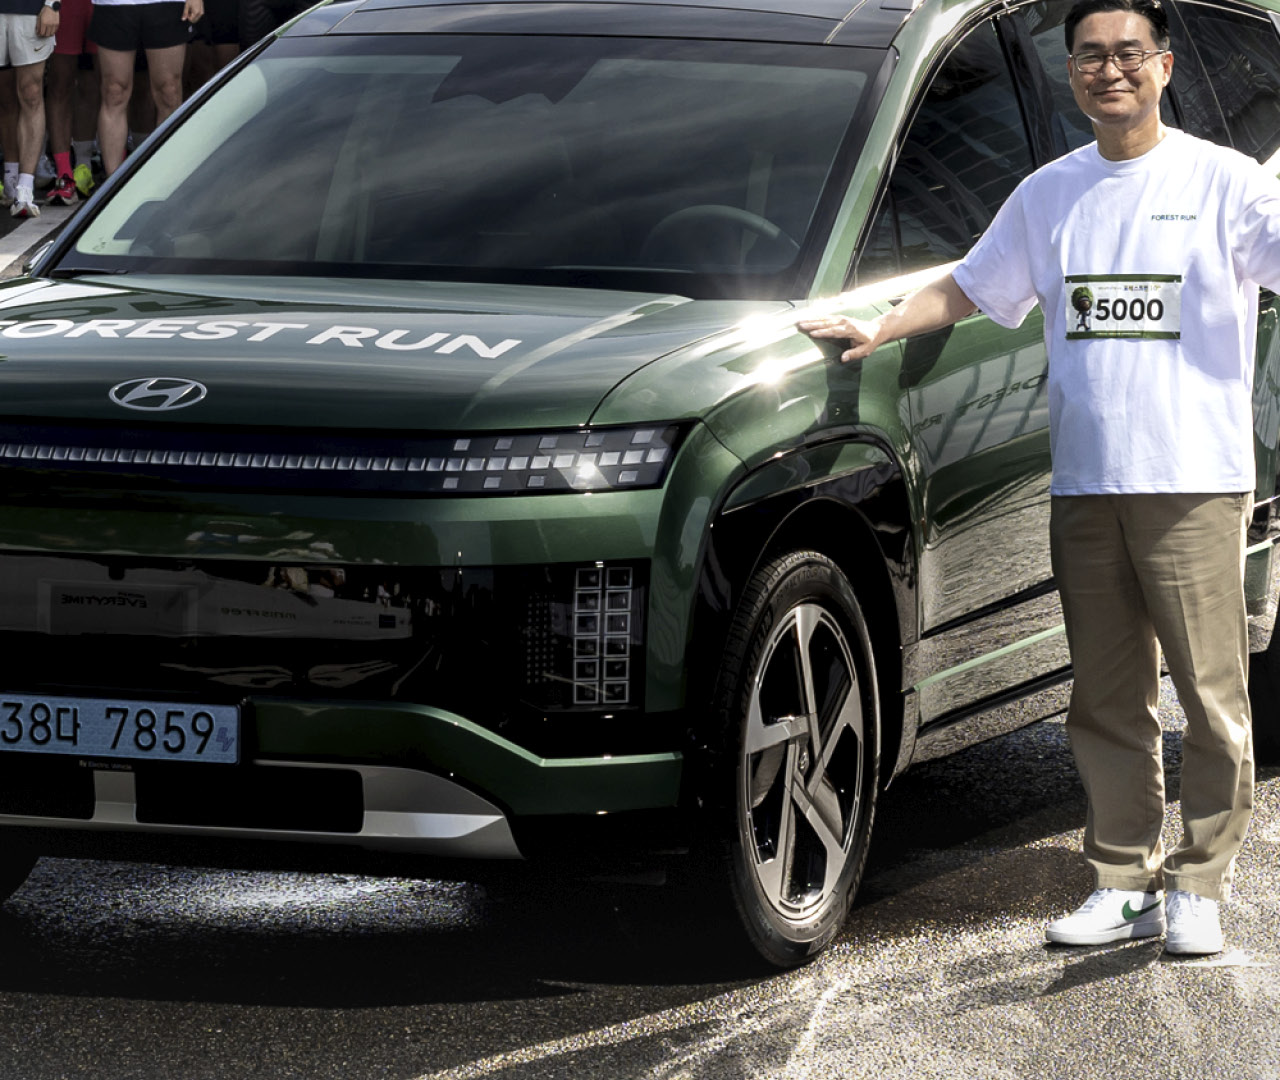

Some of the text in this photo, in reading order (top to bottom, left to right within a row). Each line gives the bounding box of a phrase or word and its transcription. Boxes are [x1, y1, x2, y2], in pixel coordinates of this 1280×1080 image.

[1095, 297, 1164, 321] 5000
[307, 325, 521, 360] RUN
[1, 701, 81, 746] 38다
[104, 706, 215, 755] 7859
